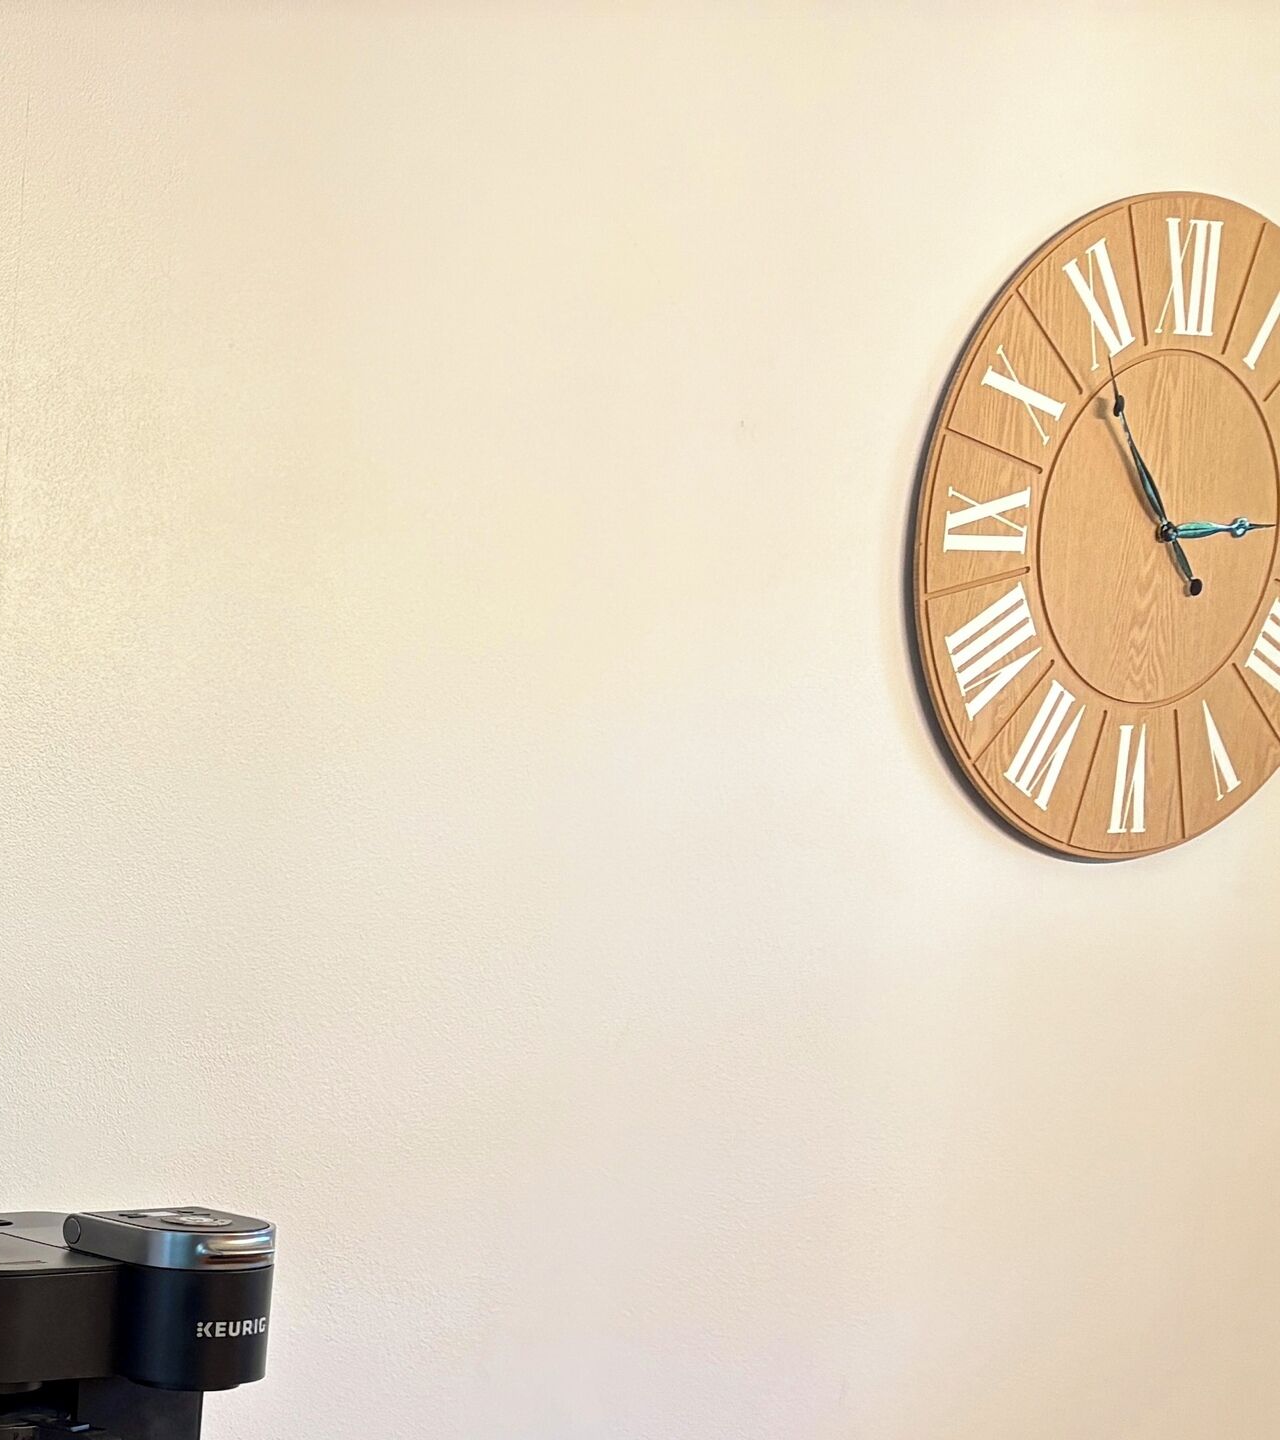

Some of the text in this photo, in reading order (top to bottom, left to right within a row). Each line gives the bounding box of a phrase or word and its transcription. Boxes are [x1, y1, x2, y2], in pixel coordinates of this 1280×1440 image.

[1062, 237, 1136, 371] XI
[1154, 217, 1223, 337] XII
[980, 344, 1067, 445] X
[943, 486, 1031, 554] IX
[944, 581, 1043, 721] VIII
[1002, 678, 1087, 811] VII
[1106, 722, 1147, 834] VI
[1201, 699, 1241, 801] V
[197, 1317, 266, 1338] KEURIG
